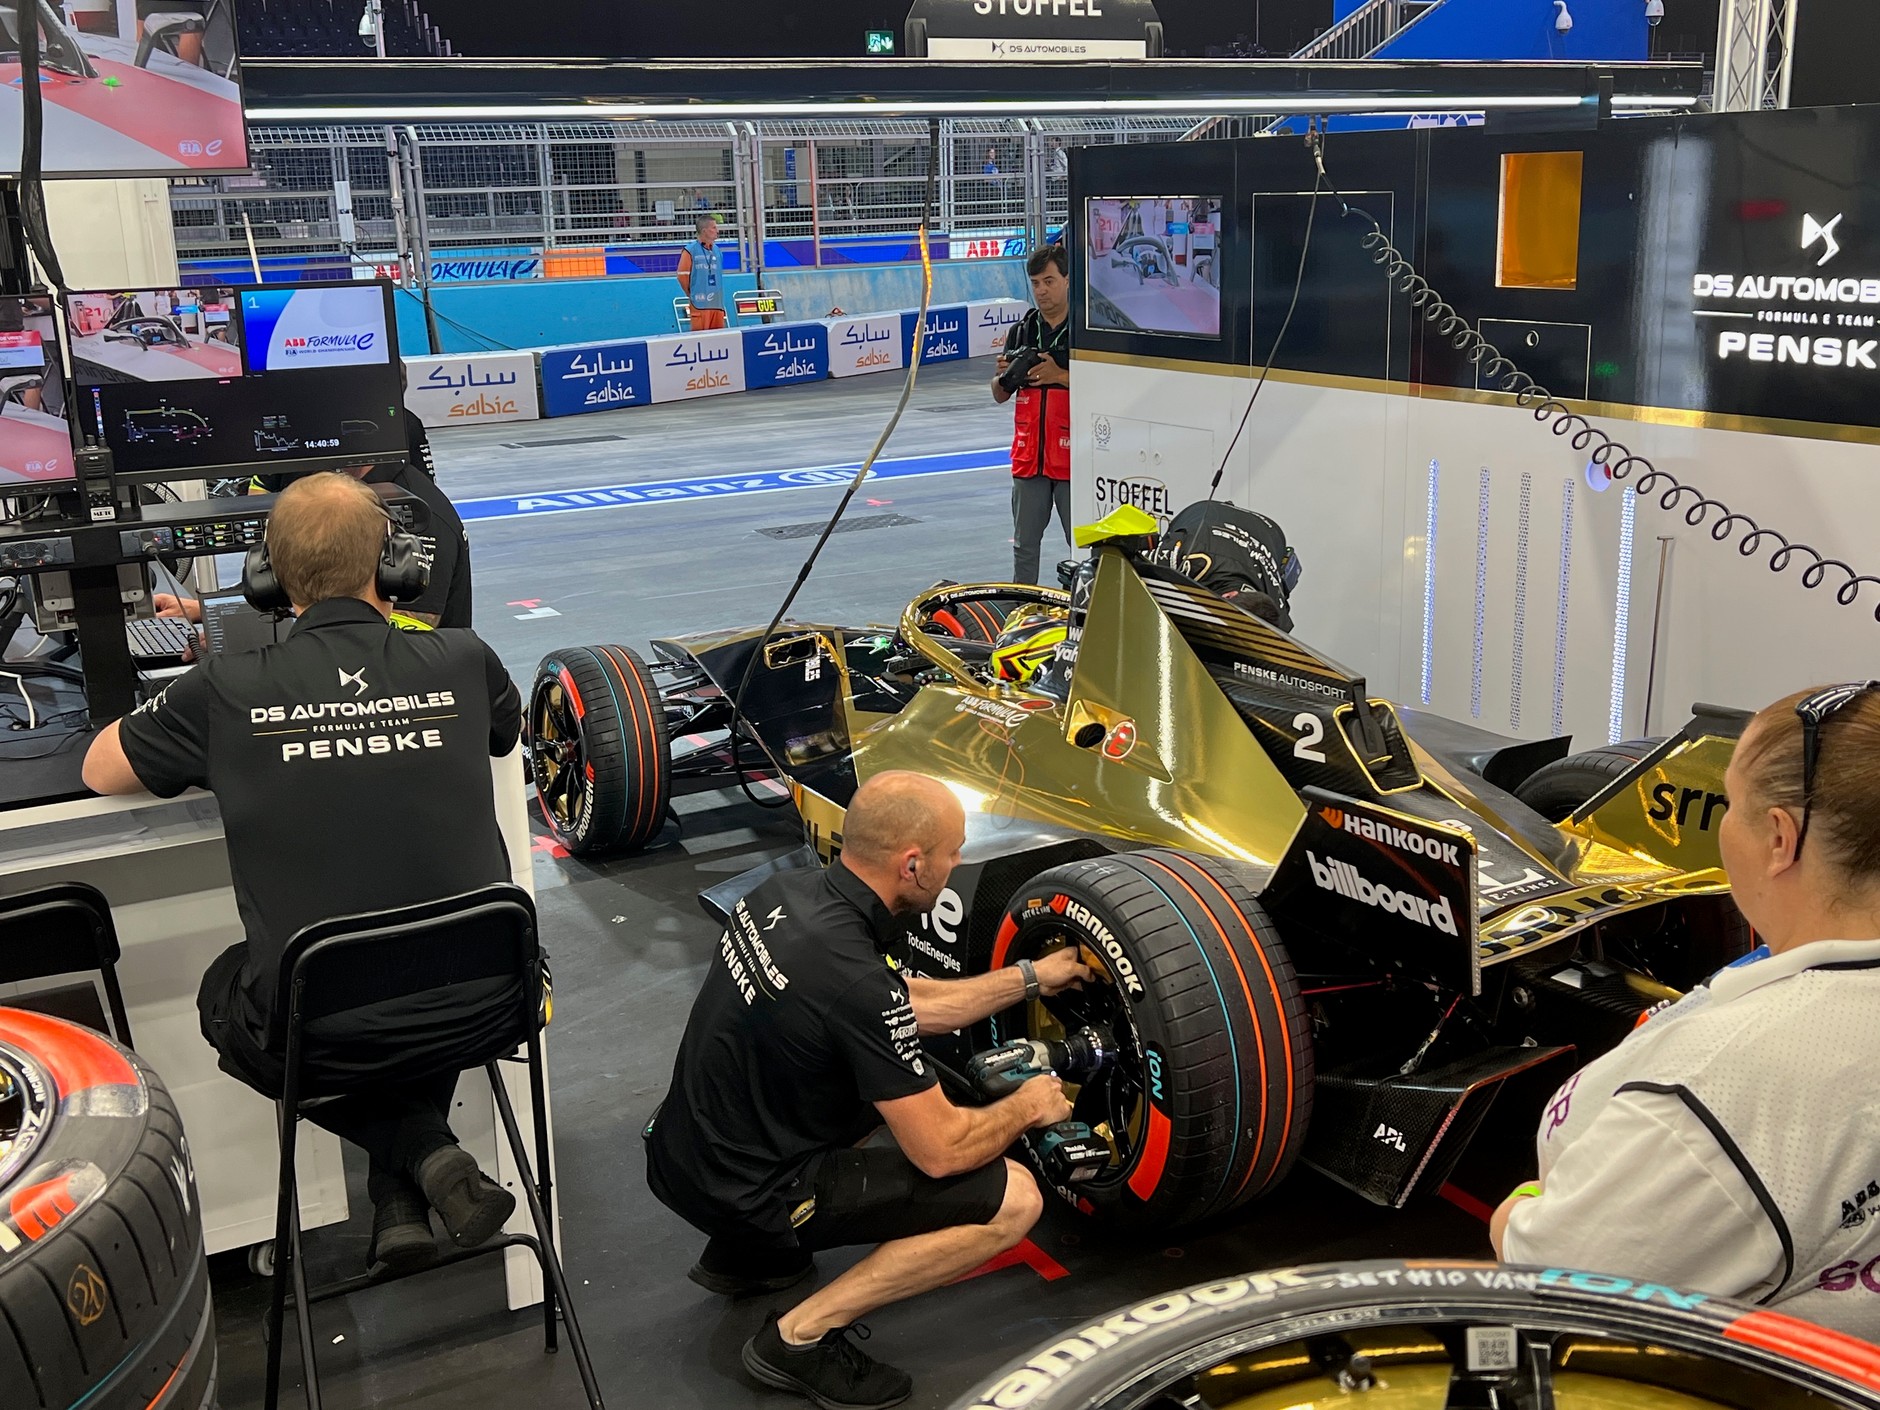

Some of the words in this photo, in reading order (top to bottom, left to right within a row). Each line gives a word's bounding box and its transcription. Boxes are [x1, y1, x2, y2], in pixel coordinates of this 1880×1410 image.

[966, 240, 1001, 258] ABB
[430, 260, 509, 281] ORMULA
[1693, 274, 1734, 298] DS
[757, 299, 776, 312] GUE
[1757, 311, 1818, 324] FORMULA
[1822, 313, 1831, 325] E
[1837, 314, 1874, 327] TEAM
[284, 338, 306, 348] ABB
[306, 334, 357, 348] FORMULA
[775, 357, 817, 379] sabic
[856, 347, 891, 368] sabic
[685, 368, 731, 391] sabic
[584, 380, 636, 405] sabic
[447, 393, 519, 418] sabic
[304, 438, 340, 449] 14:40:59
[511, 476, 778, 513] Allianz
[1095, 476, 1174, 516] STOFFEL
[1233, 661, 1277, 681] PENSKE
[1277, 673, 1347, 700] AUTOSPORT
[251, 705, 286, 724] DS
[290, 690, 455, 721] AUTOMOBILES
[312, 722, 366, 733] FORMULA
[369, 721, 376, 729] E
[380, 717, 410, 728] TEAM
[282, 729, 443, 762] PENSKE
[1293, 712, 1327, 764] 2
[1306, 850, 1459, 937] billboard
[739, 909, 789, 991] AUTOMOBILES
[906, 930, 961, 973] TotalEnergies
[720, 930, 757, 1005] PENSKE
[22, 1067, 47, 1102] RACING
[1339, 1270, 1401, 1289] SET
[1473, 1269, 1538, 1292] VAN
